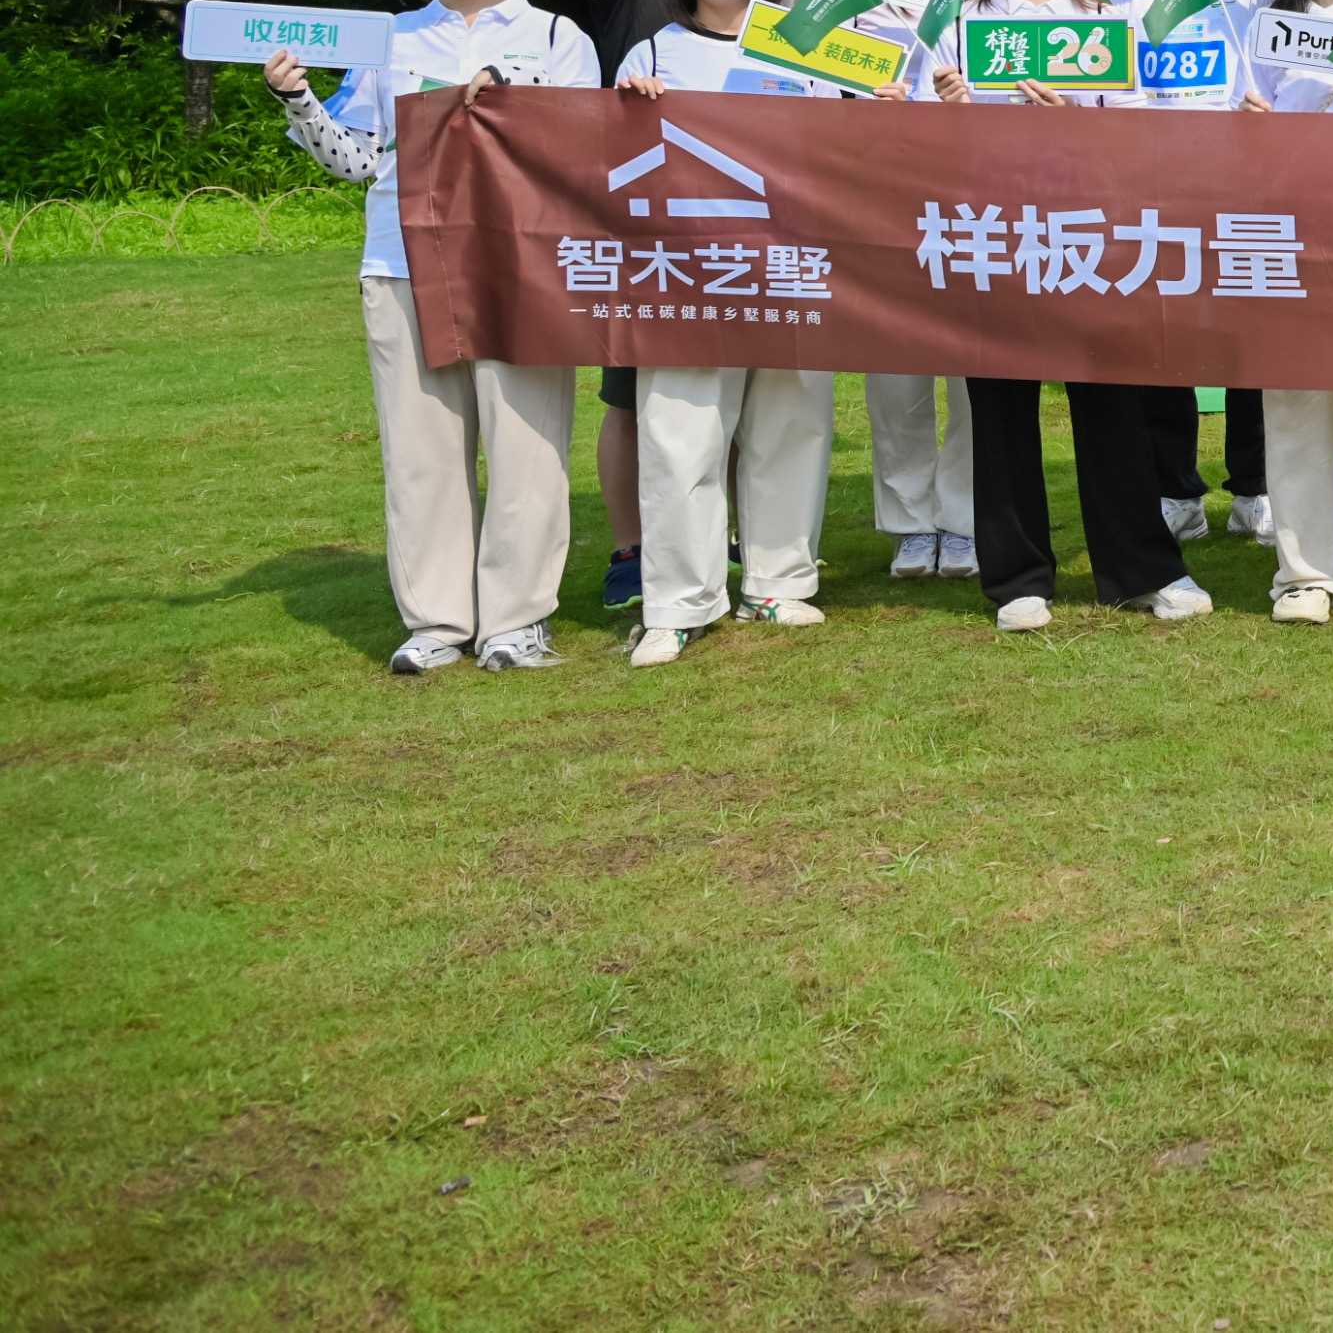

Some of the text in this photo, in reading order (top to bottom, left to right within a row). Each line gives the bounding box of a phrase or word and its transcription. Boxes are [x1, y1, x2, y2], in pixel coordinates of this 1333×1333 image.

[243, 18, 339, 48] 收纳刻
[823, 41, 893, 75] 装配未来
[1143, 50, 1220, 80] 0287
[557, 236, 832, 299] 智木艺墅
[569, 303, 822, 325] 一站式低碳健康乡墅服务商
